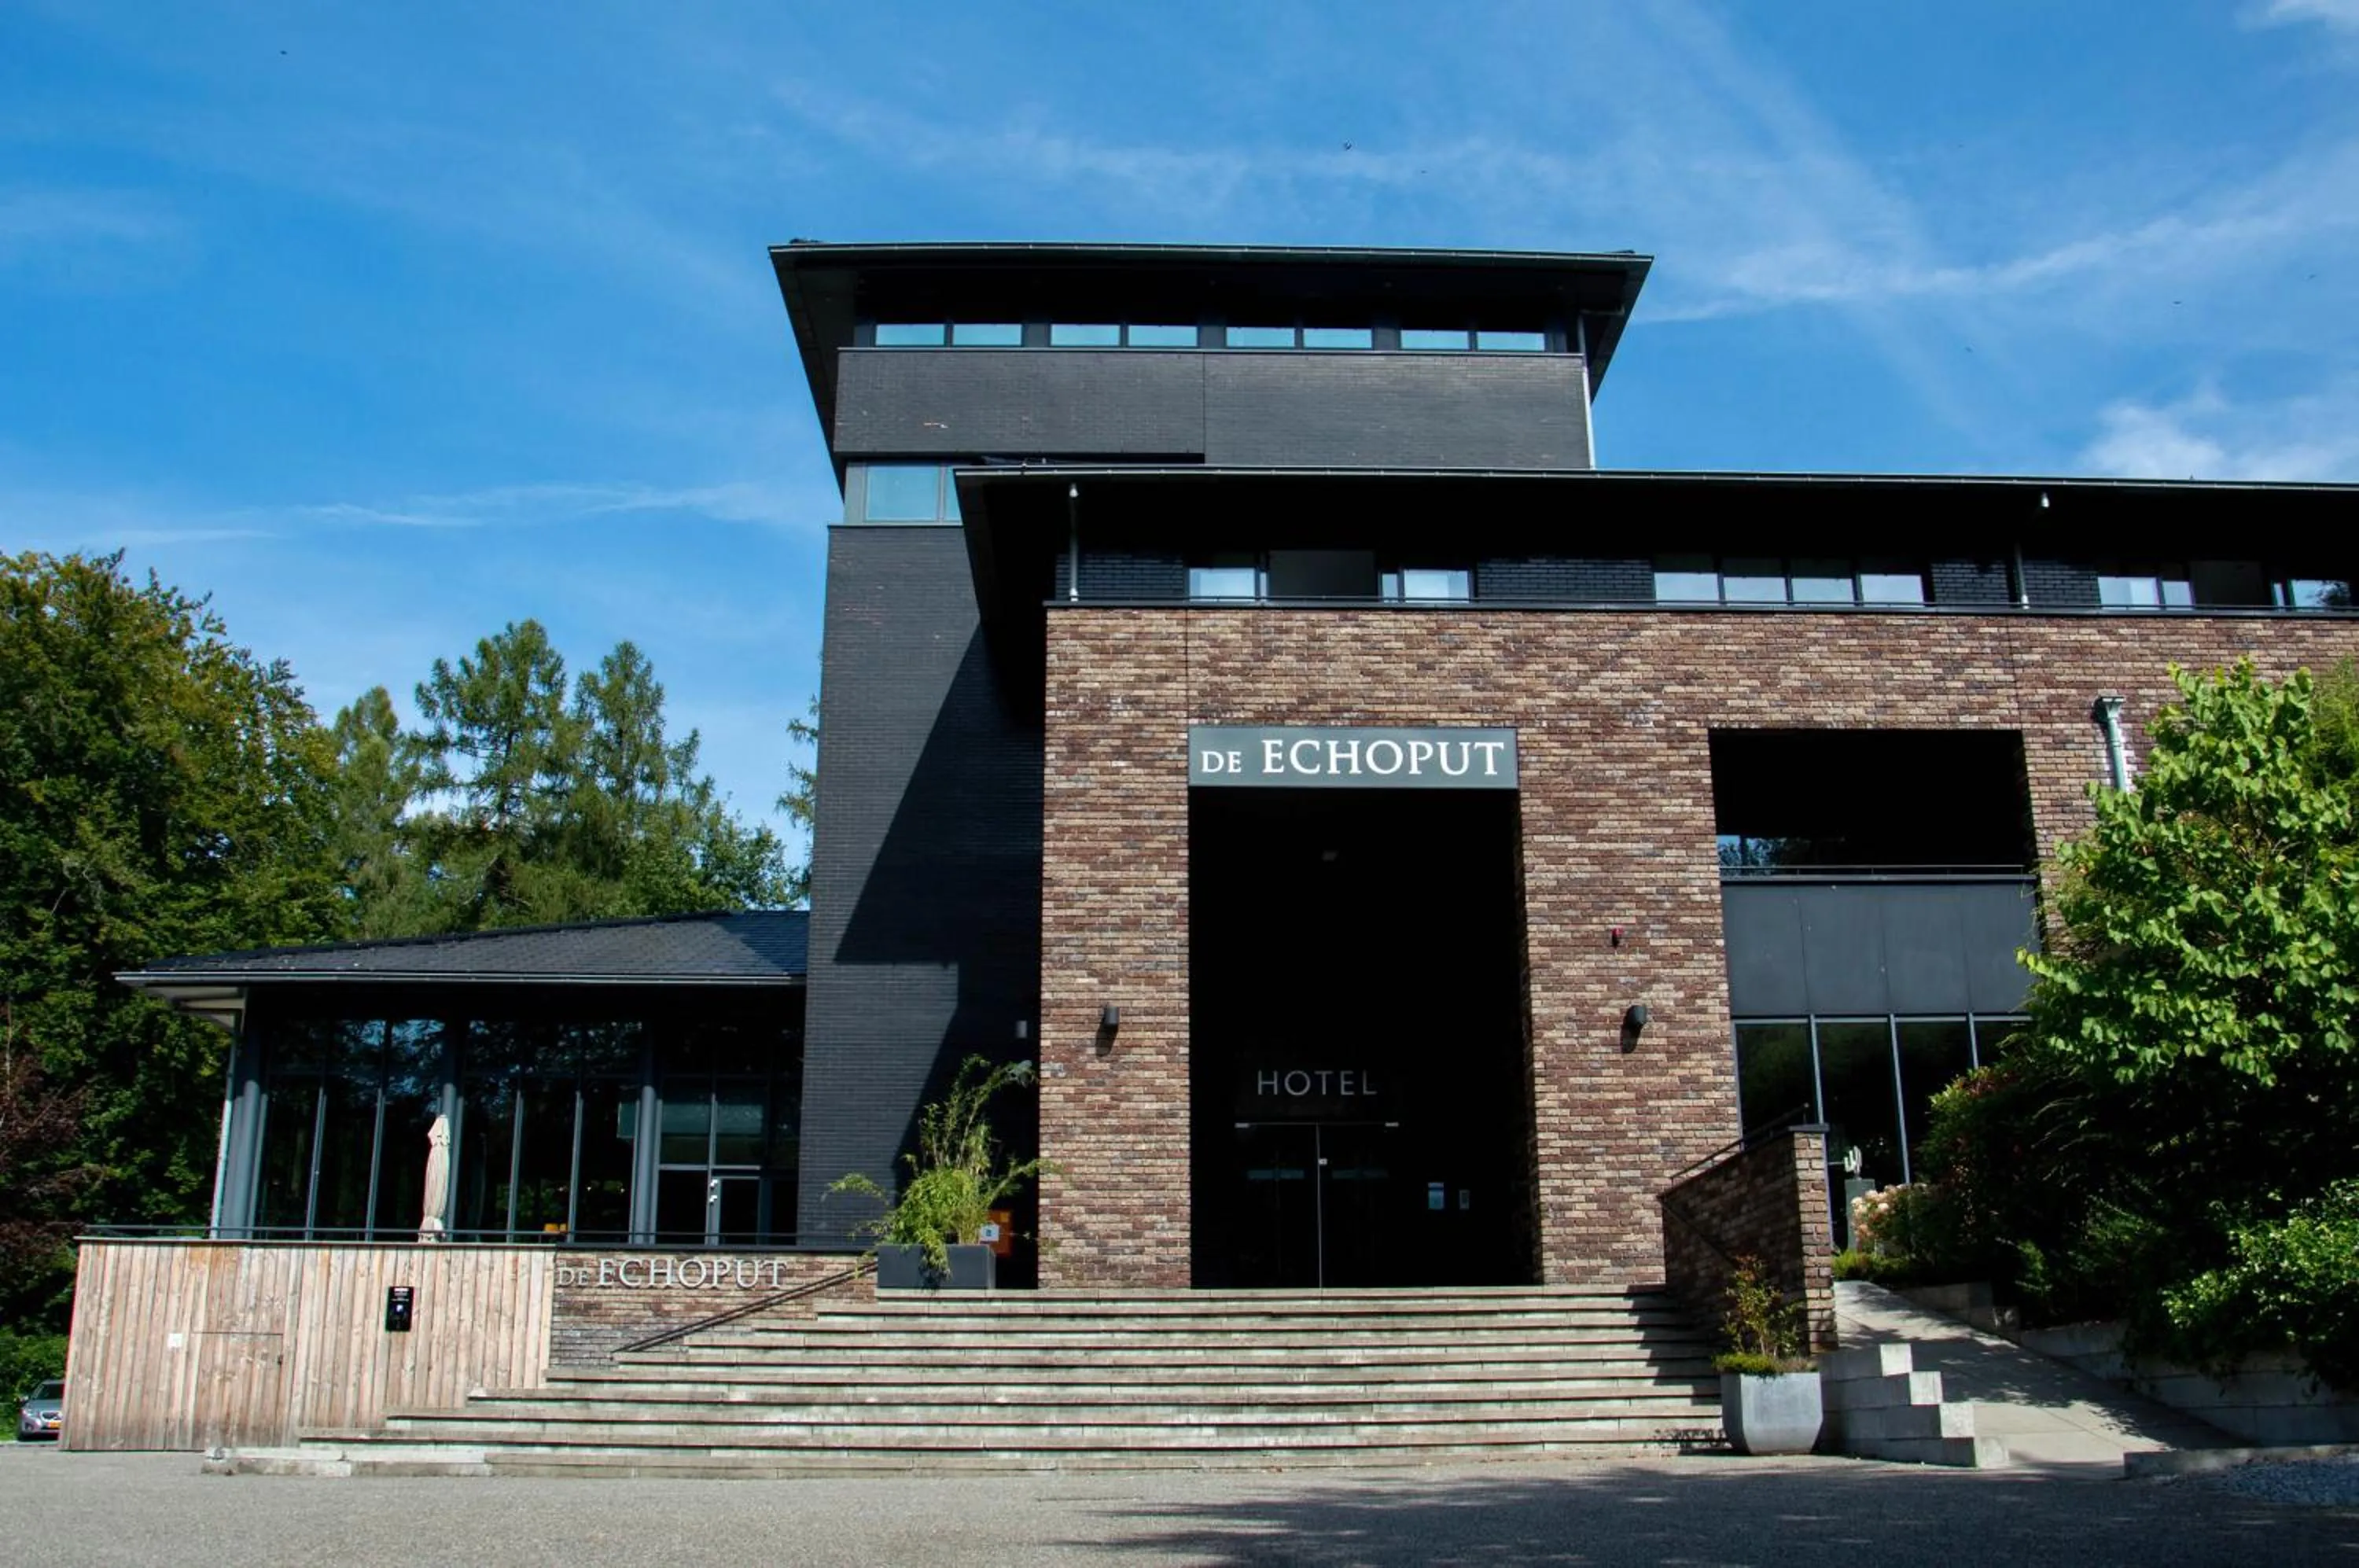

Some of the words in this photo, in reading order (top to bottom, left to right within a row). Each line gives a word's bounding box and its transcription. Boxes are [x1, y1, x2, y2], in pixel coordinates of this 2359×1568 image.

[1201, 750, 1242, 774] DE
[1261, 738, 1504, 775] ECHOPUT
[1257, 1069, 1378, 1095] HOTEL
[558, 1267, 589, 1286] DE
[598, 1259, 786, 1289] ECHOPUT
